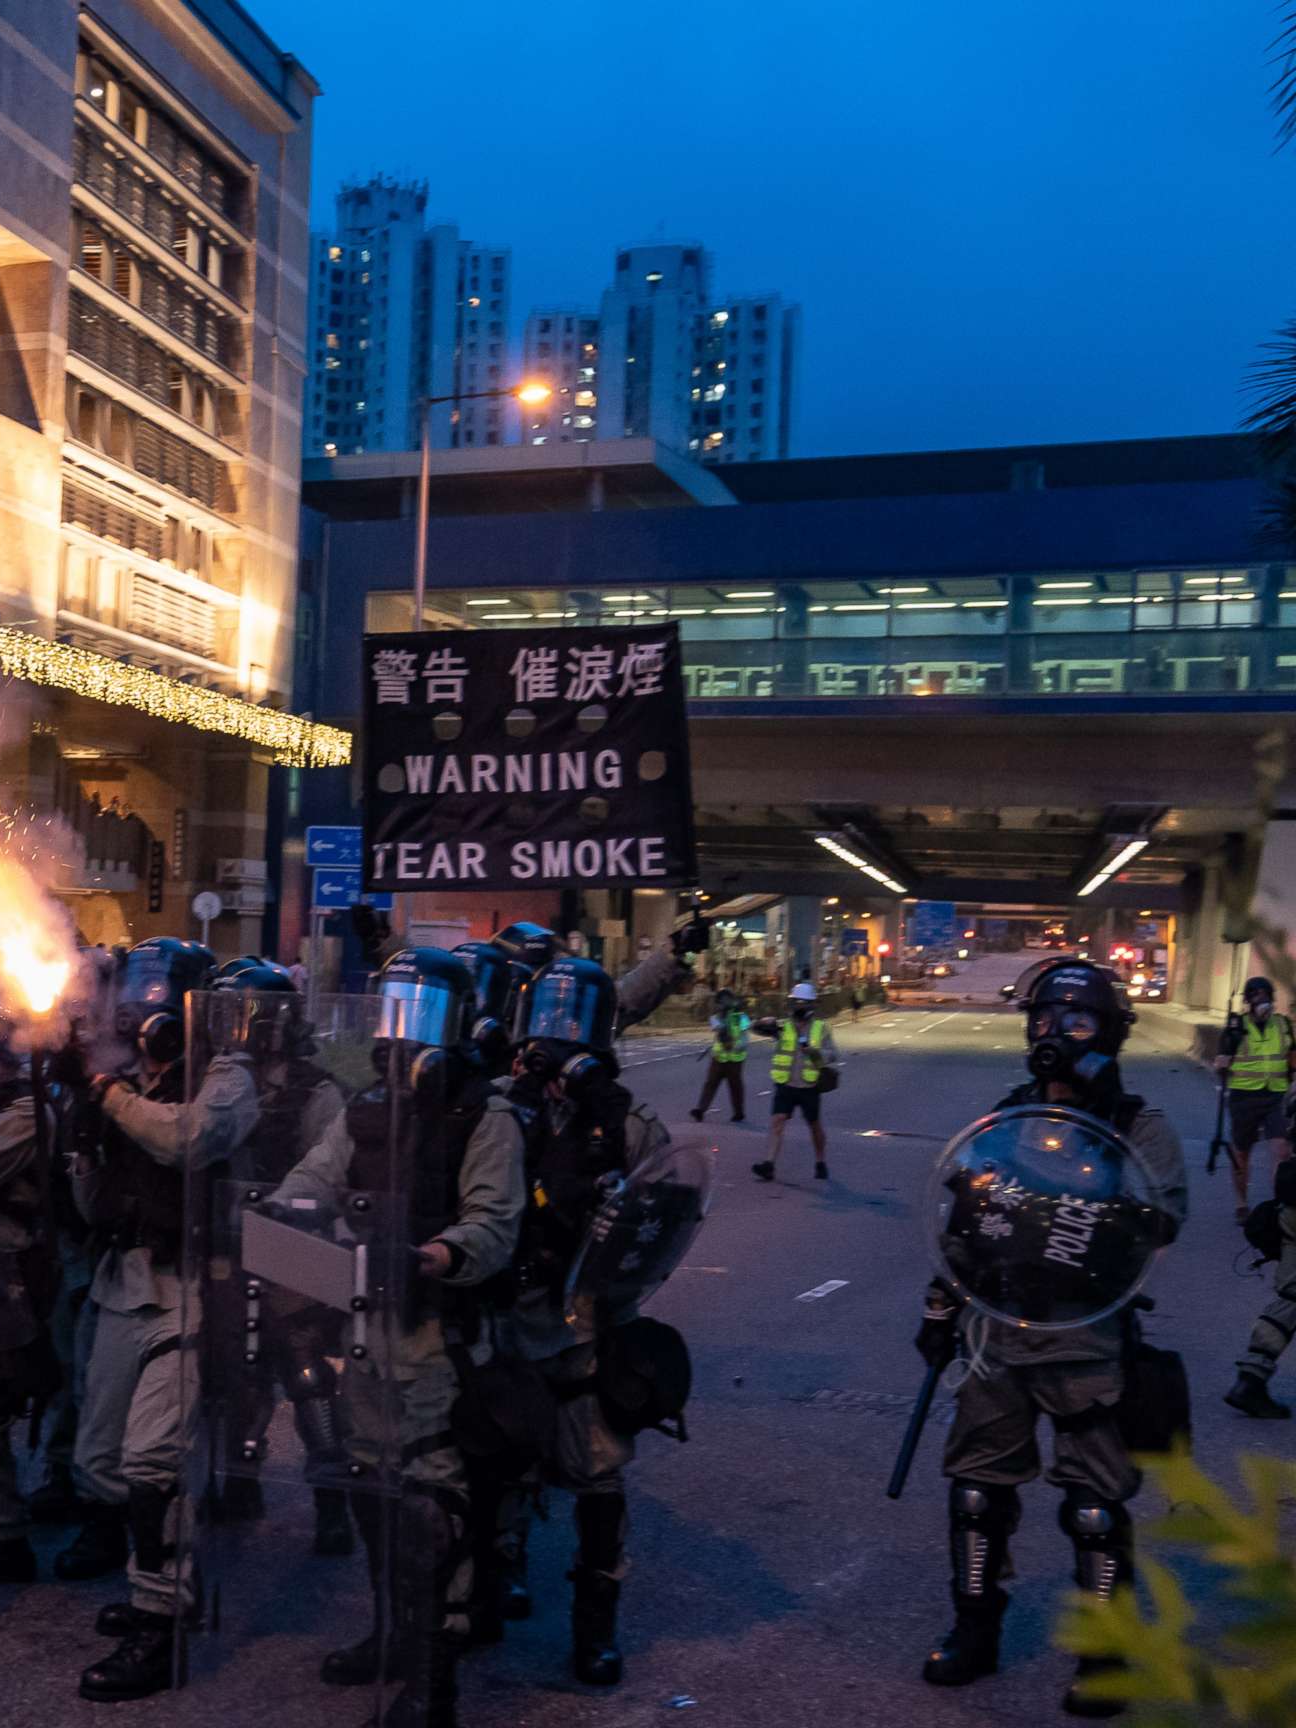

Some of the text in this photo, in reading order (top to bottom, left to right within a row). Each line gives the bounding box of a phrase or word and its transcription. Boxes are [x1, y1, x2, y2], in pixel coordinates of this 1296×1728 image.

[371, 642, 667, 705] 警告 催淚煙
[406, 749, 623, 794] WARNING
[371, 837, 667, 880] TEAR SMOKE
[1043, 1193, 1101, 1267] POLICE
